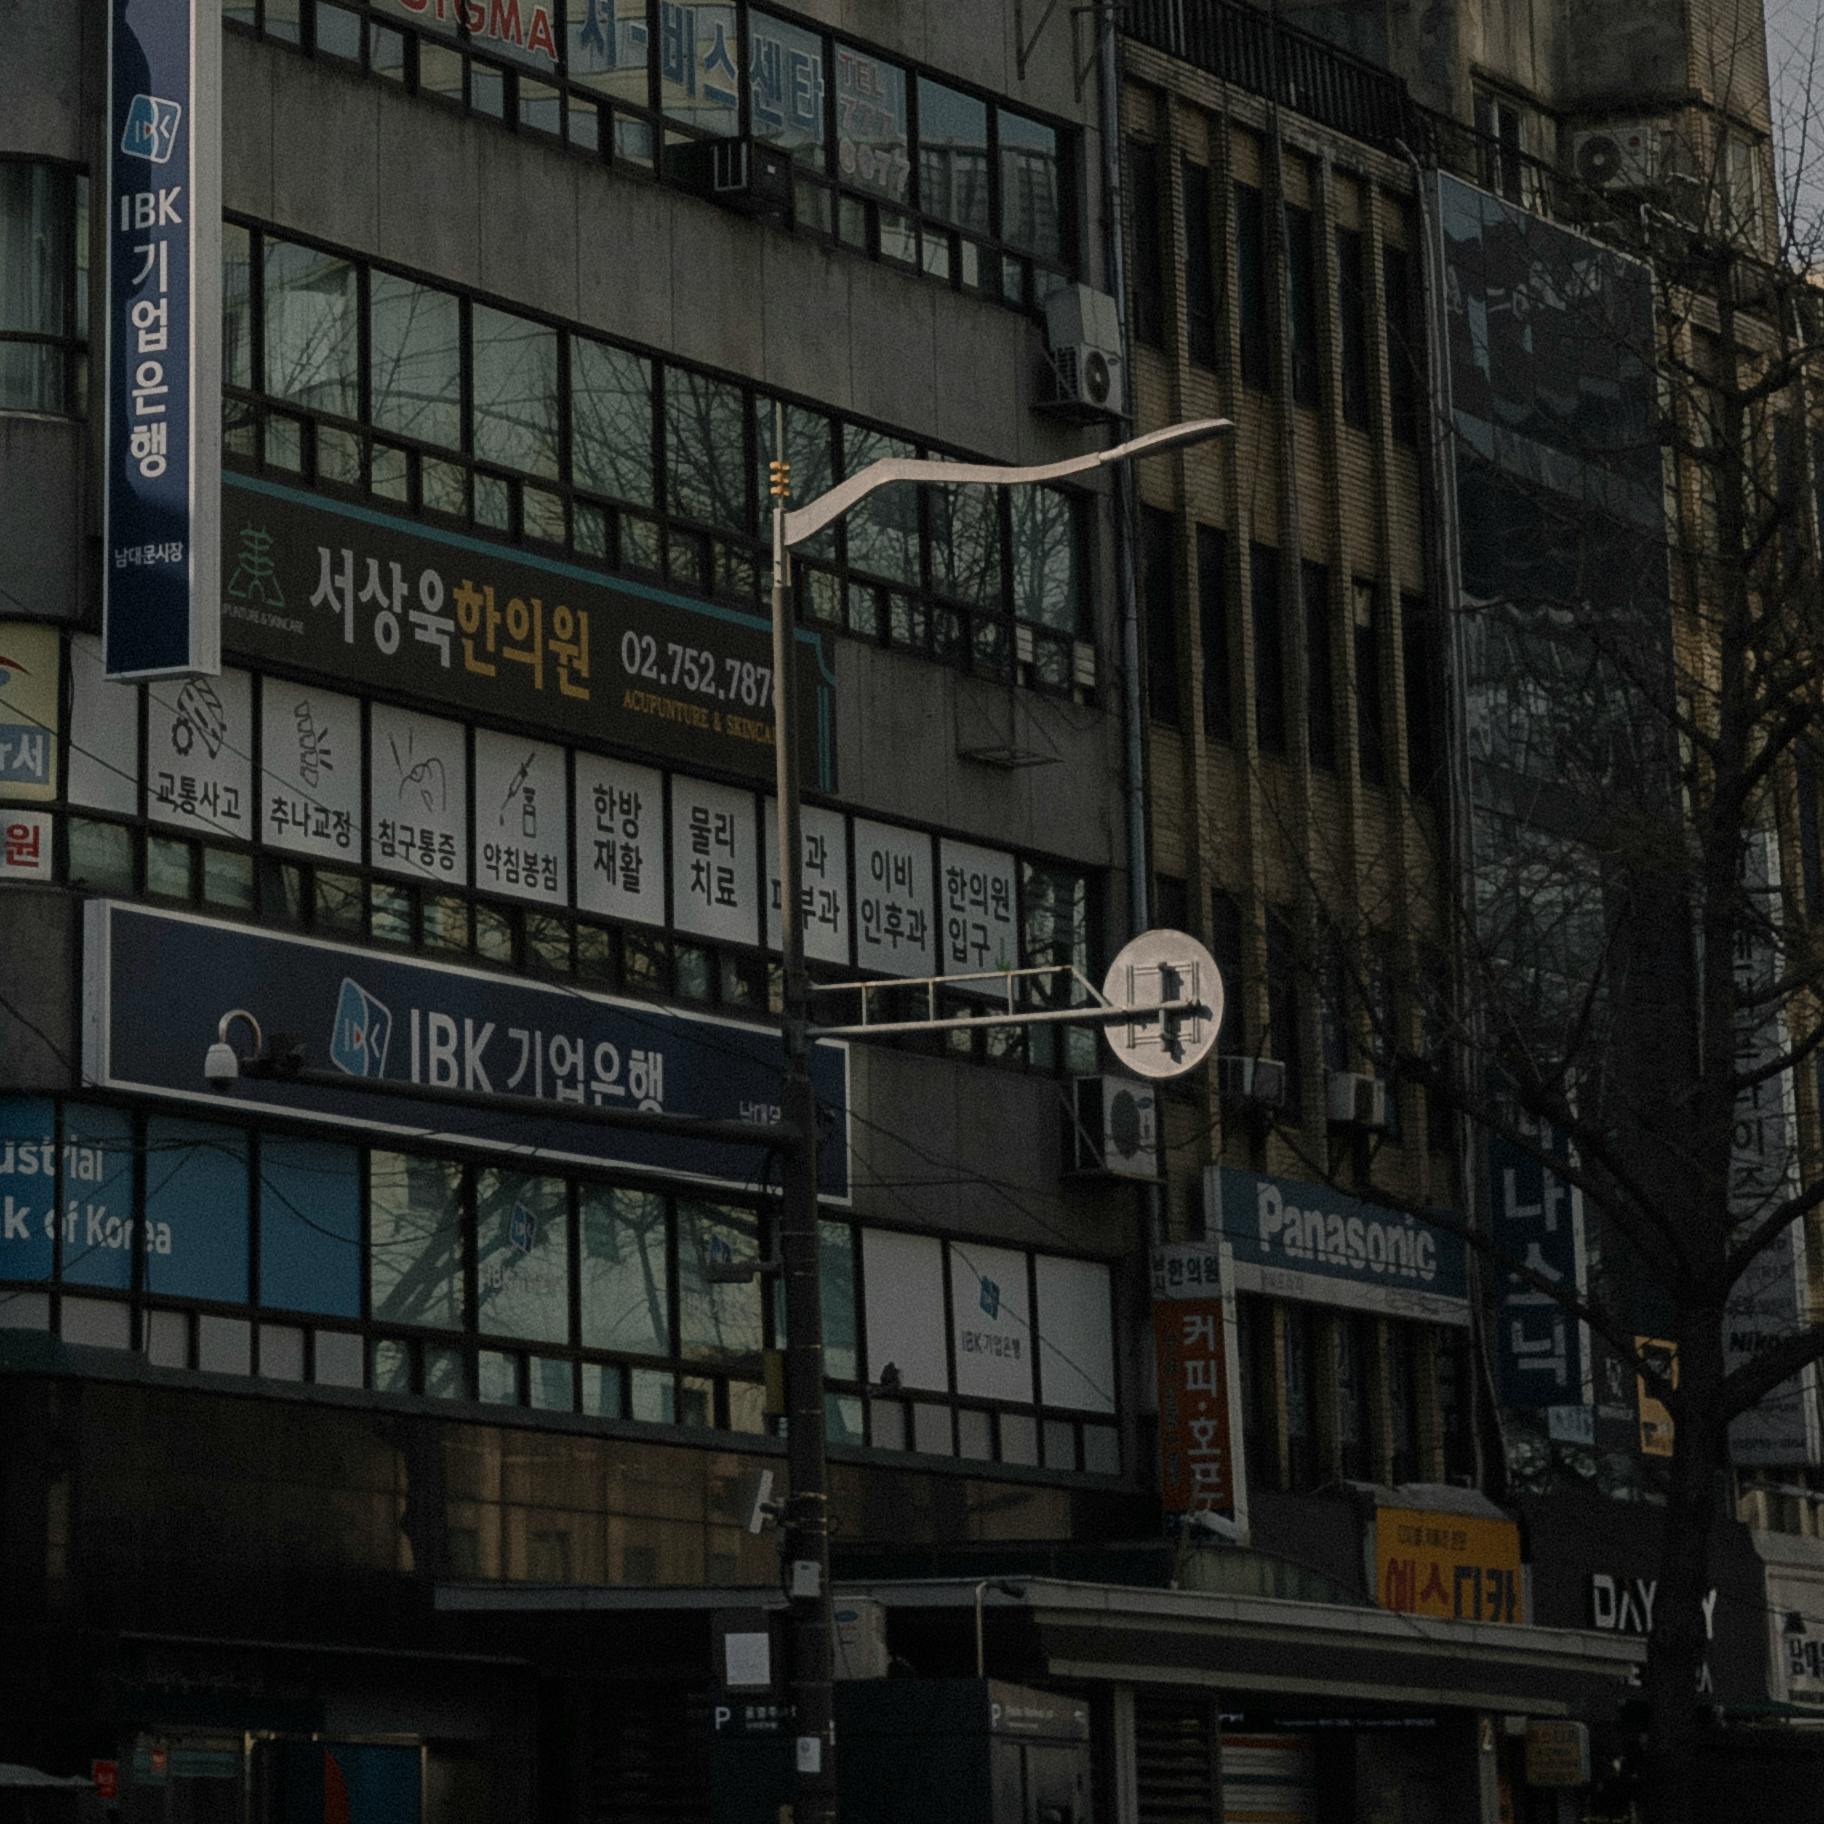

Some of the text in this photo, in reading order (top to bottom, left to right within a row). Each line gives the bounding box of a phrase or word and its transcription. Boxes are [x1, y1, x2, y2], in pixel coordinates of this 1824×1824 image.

[119, 187, 182, 234] IBK
[125, 236, 170, 481] 기업은행
[114, 540, 183, 569] 남대문시장
[620, 629, 777, 710] 02.752.787
[155, 771, 242, 822] 교통사고
[269, 796, 353, 850] 추나교정
[592, 783, 642, 840] 한방
[376, 818, 457, 872] 침구통증
[689, 803, 736, 859] 물리
[482, 841, 560, 893] 약침봉침
[592, 838, 643, 894] 재활
[689, 859, 738, 909] 치료
[870, 849, 914, 898] 이비
[945, 864, 1013, 925] 한의원
[860, 898, 928, 952] 인후과
[948, 917, 992, 969] 입구
[44, 1199, 78, 1243] of
[85, 1203, 173, 1255] Korea
[1256, 1182, 1438, 1282] Panasonic
